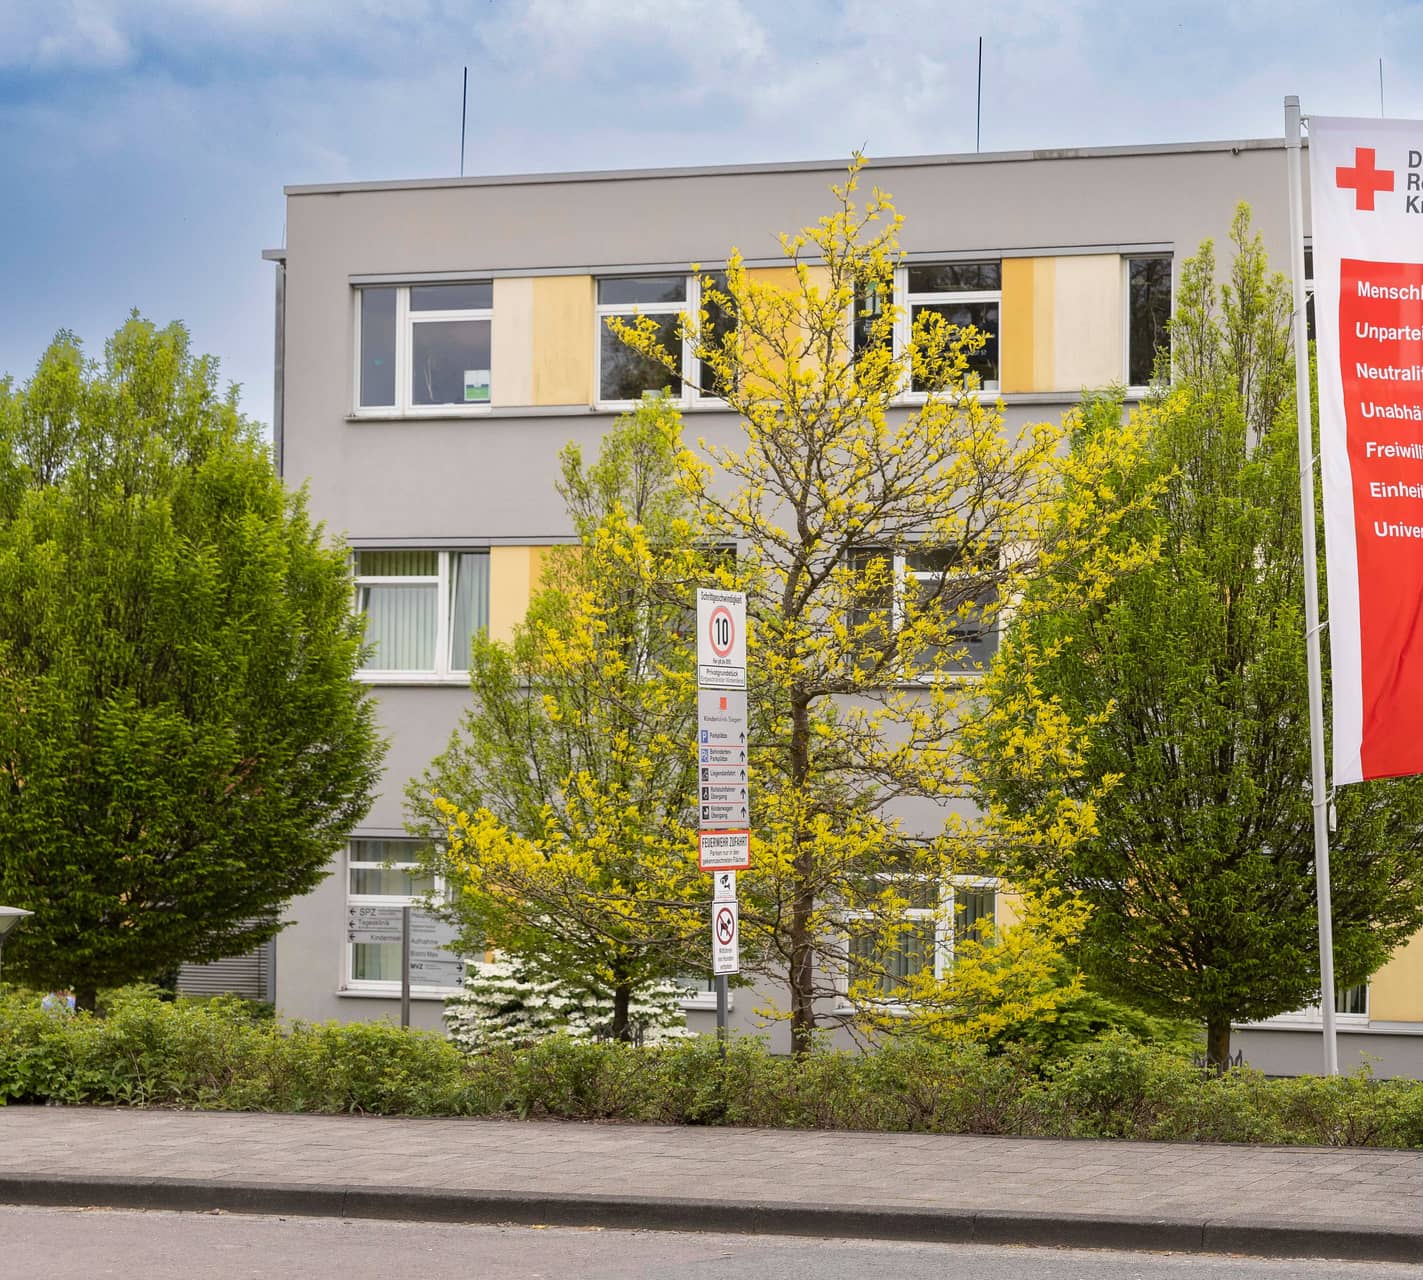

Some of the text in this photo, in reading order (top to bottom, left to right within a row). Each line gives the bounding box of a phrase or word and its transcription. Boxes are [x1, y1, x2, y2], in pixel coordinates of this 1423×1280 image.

[715, 617, 729, 646] 10
[702, 836, 748, 848] FEUERWEHR ZUFAHRT
[359, 907, 377, 917] SPZ
